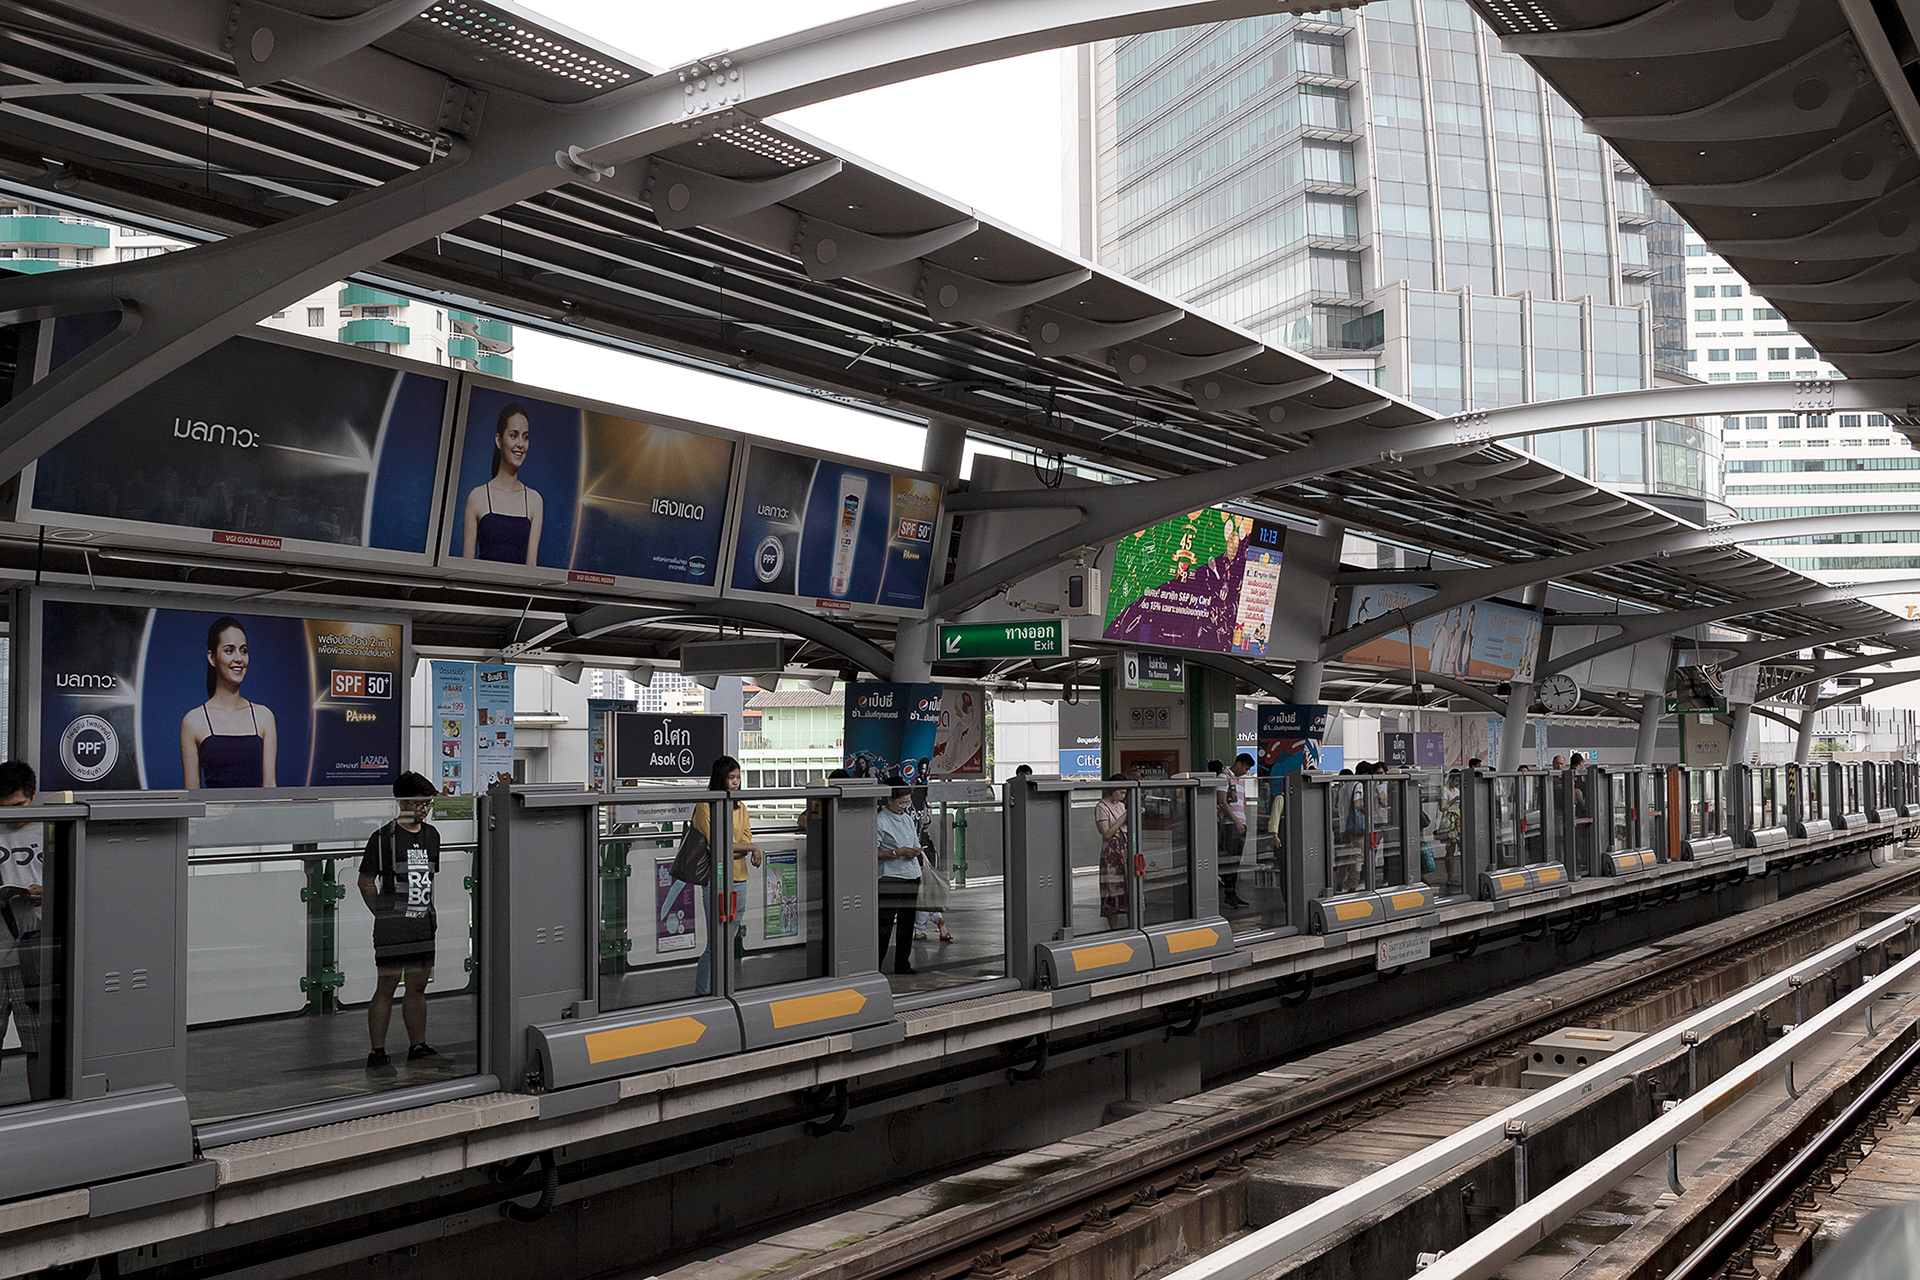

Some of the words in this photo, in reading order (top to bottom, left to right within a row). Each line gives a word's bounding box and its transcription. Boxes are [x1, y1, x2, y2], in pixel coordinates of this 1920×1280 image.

[174, 417, 260, 448] มลภาวะ
[651, 498, 705, 521] แสงแดด
[757, 504, 790, 519] มลภาวะ
[900, 521, 917, 536] SPF
[225, 534, 237, 543] VGI
[237, 536, 261, 546] GLOBAL
[260, 539, 281, 548] MEDIA
[1259, 527, 1279, 545] 11:13
[763, 553, 777, 566] PPF
[1198, 595, 1212, 606] Card
[1004, 626, 1055, 640] ทางออก
[370, 636, 377, 647] 2
[378, 637, 387, 648] in
[387, 638, 392, 649] 1
[1033, 640, 1055, 651] Exit
[56, 673, 117, 689] มลภาวะ
[335, 674, 362, 693] SPF
[367, 676, 390, 695] 50+
[868, 692, 894, 708] เป๊ปซี่
[653, 718, 690, 746] อโศก
[77, 741, 102, 755] PPF
[360, 755, 389, 765] LAZADA
[649, 752, 677, 766] Asok
[636, 808, 667, 816] Interchange
[408, 871, 432, 888] R4
